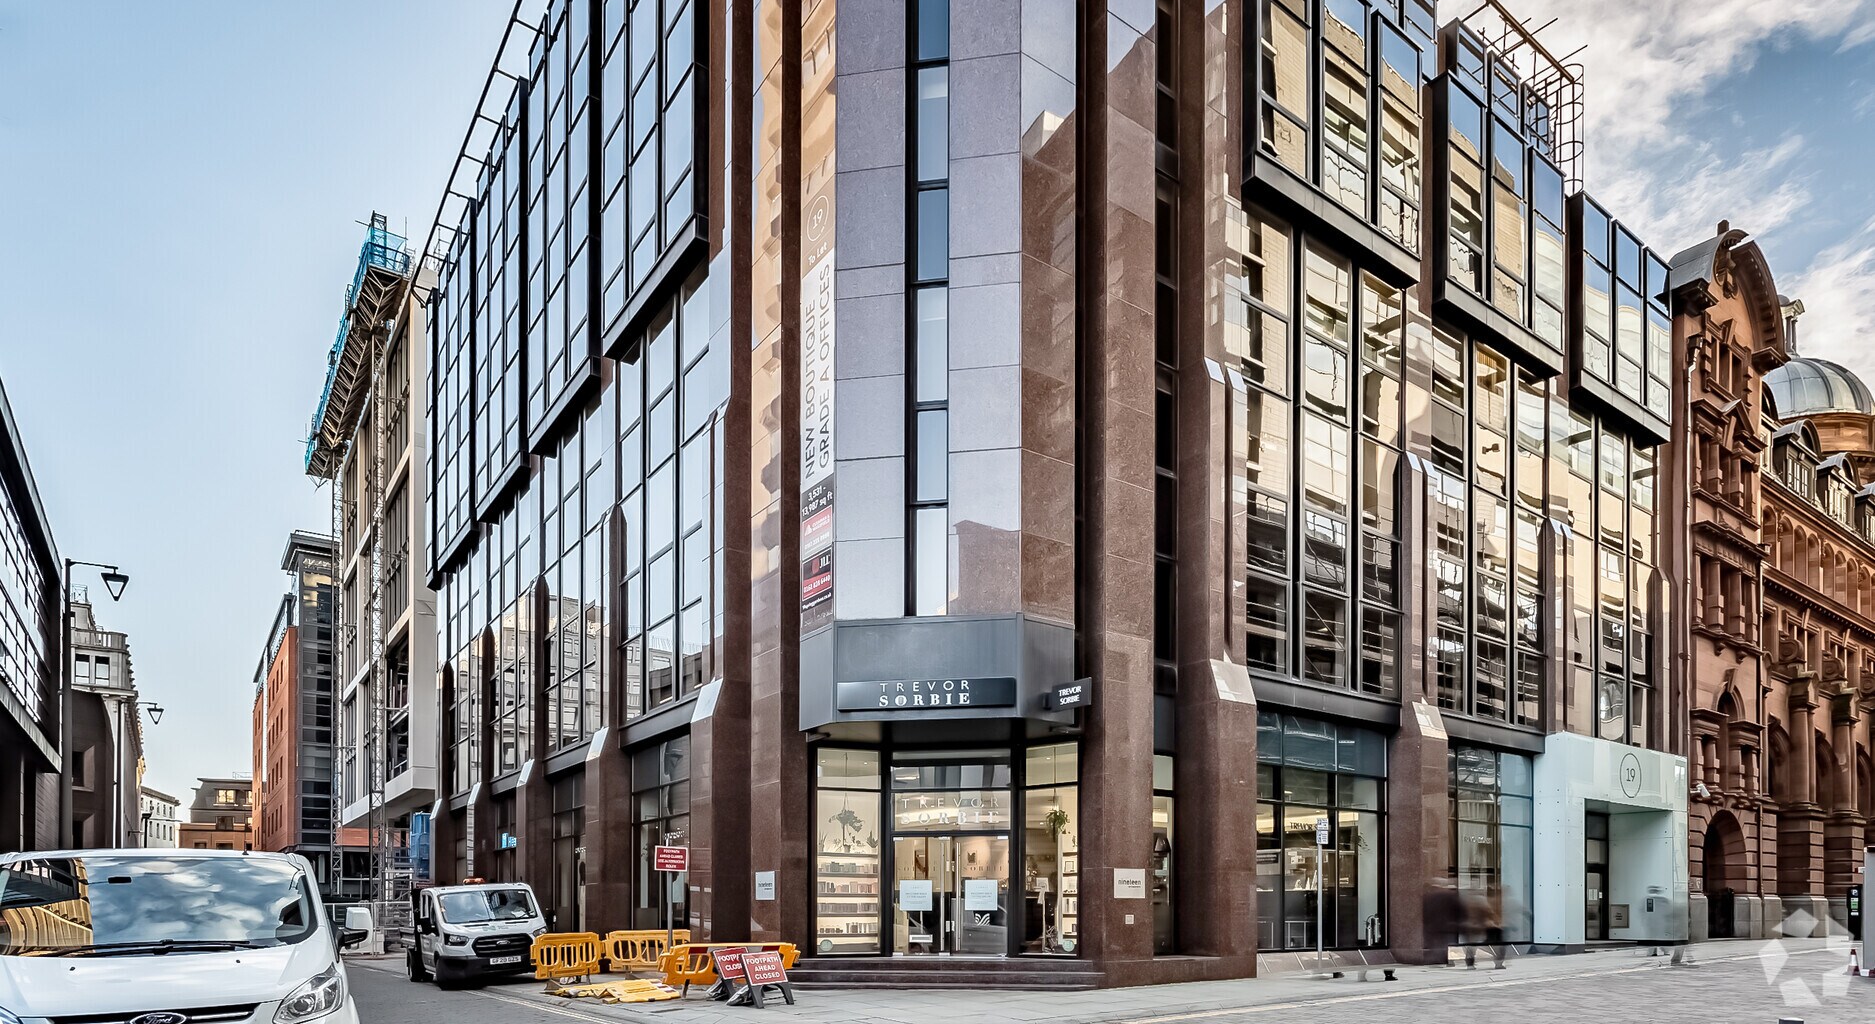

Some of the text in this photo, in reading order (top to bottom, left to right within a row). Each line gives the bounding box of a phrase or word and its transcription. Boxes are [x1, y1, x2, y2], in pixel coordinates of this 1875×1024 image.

[812, 208, 824, 230] 19
[807, 241, 828, 266] To Let
[819, 263, 830, 469] GRADE A OFFICES
[805, 299, 816, 480] NEW BOUTIQUE
[879, 679, 970, 693] TREVOR
[1058, 685, 1082, 697] TREVOR
[879, 692, 970, 707] SORBIE
[1059, 694, 1081, 705] SORBIE
[1626, 767, 1636, 782] 19
[901, 797, 999, 809] TREVOR
[900, 811, 1000, 825] SORBIE
[1290, 821, 1313, 831] TREVOR
[745, 956, 779, 965] FOOTPATH
[754, 964, 776, 972] AHEAD
[754, 971, 781, 980] CLOSED
